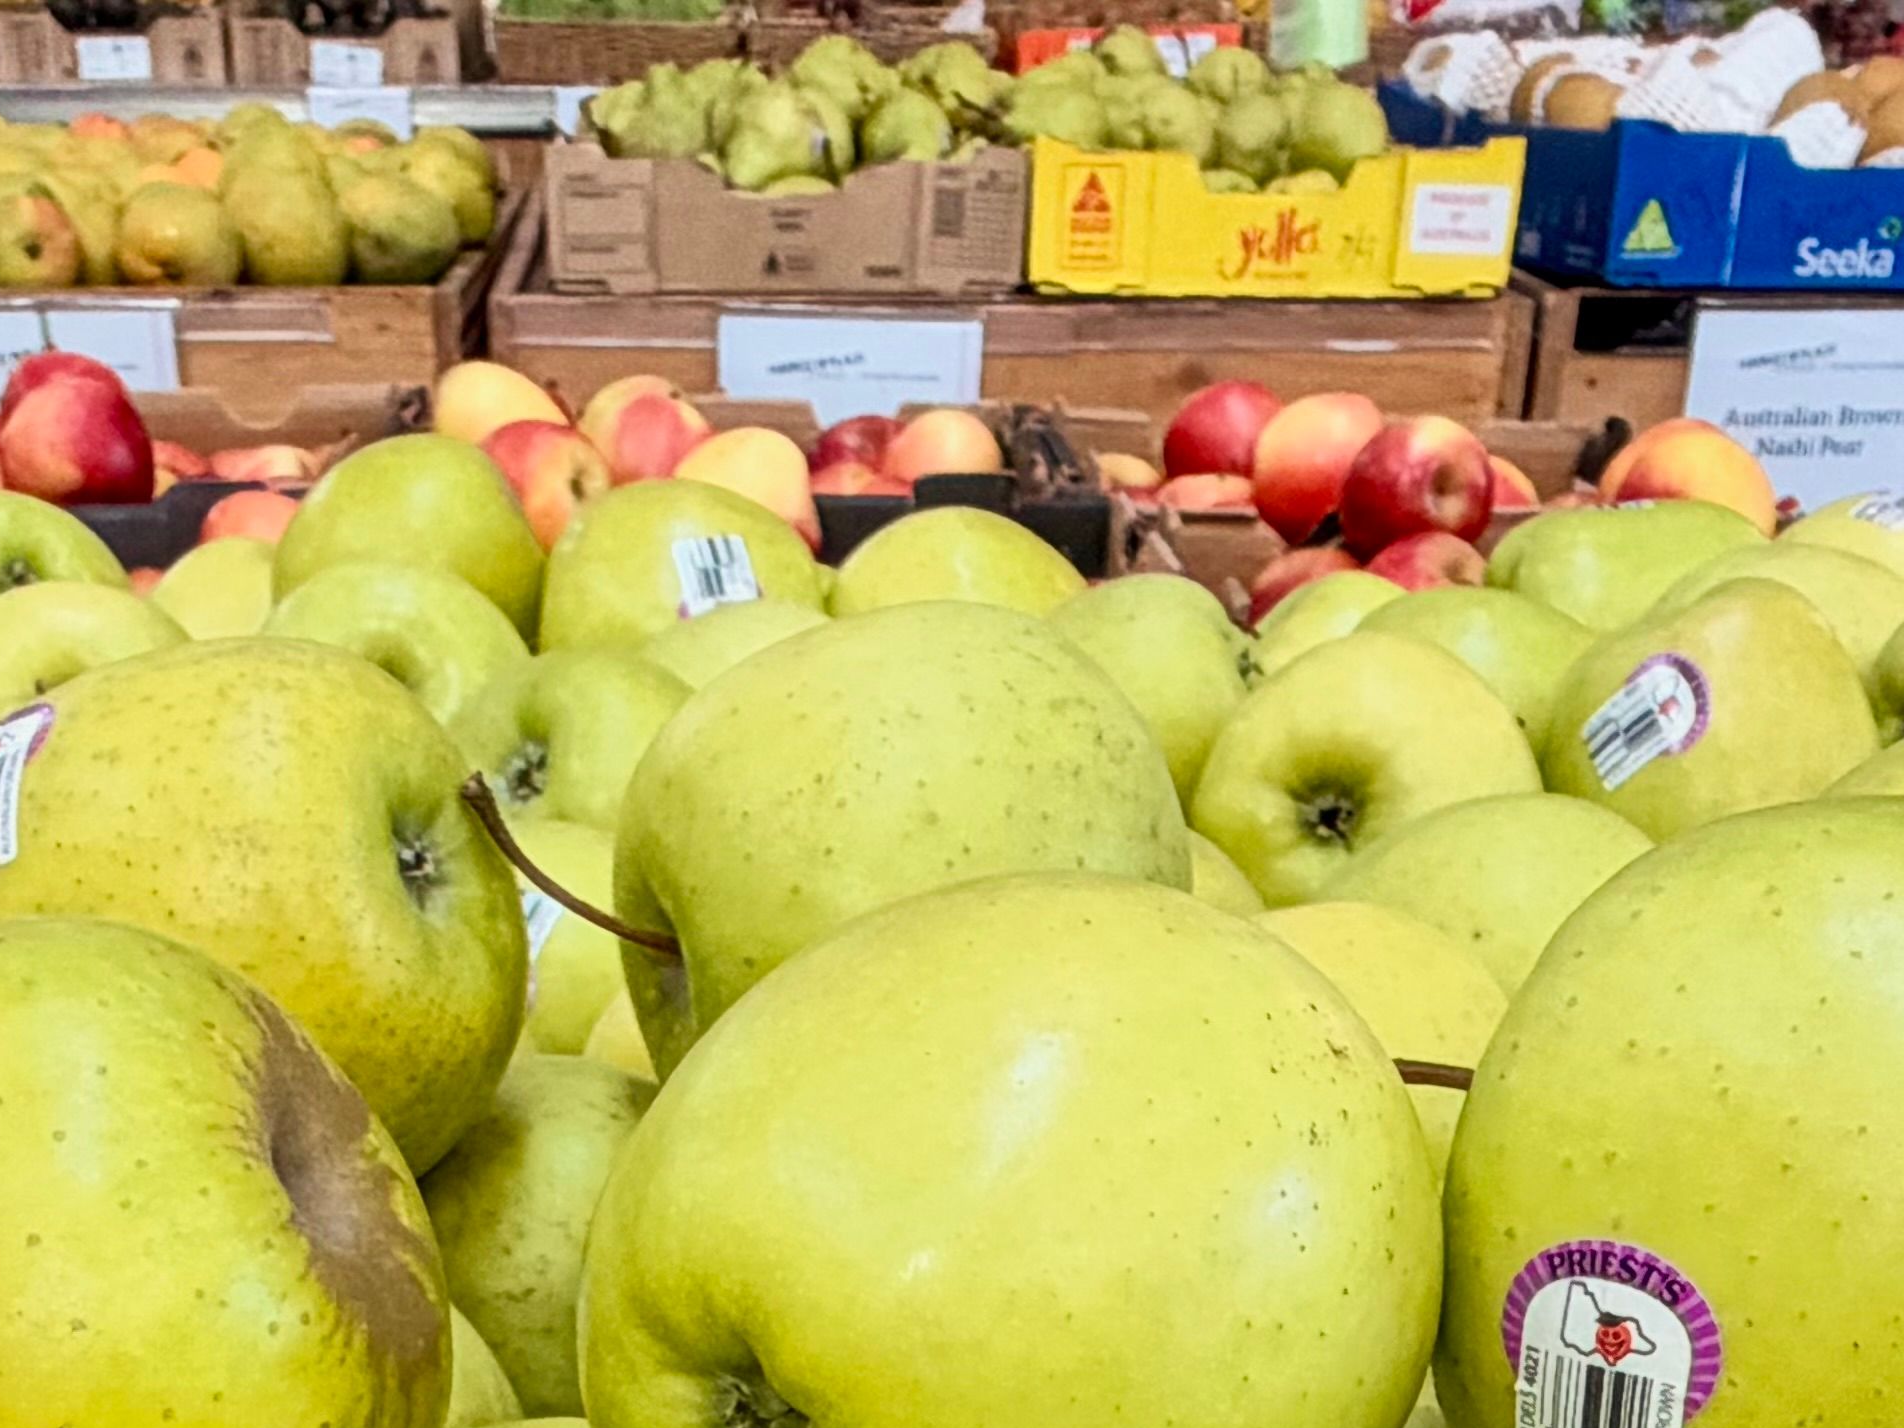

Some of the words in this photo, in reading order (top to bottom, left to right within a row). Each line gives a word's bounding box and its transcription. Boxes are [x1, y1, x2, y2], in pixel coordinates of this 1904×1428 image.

[1793, 236, 1895, 279] Seeka
[1724, 405, 1833, 428] Australian
[1756, 436, 1815, 458] Nashi
[1821, 437, 1864, 457] Pear
[1547, 1248, 1687, 1305] PRIEST'S
[1525, 1345, 1541, 1388] 4021
